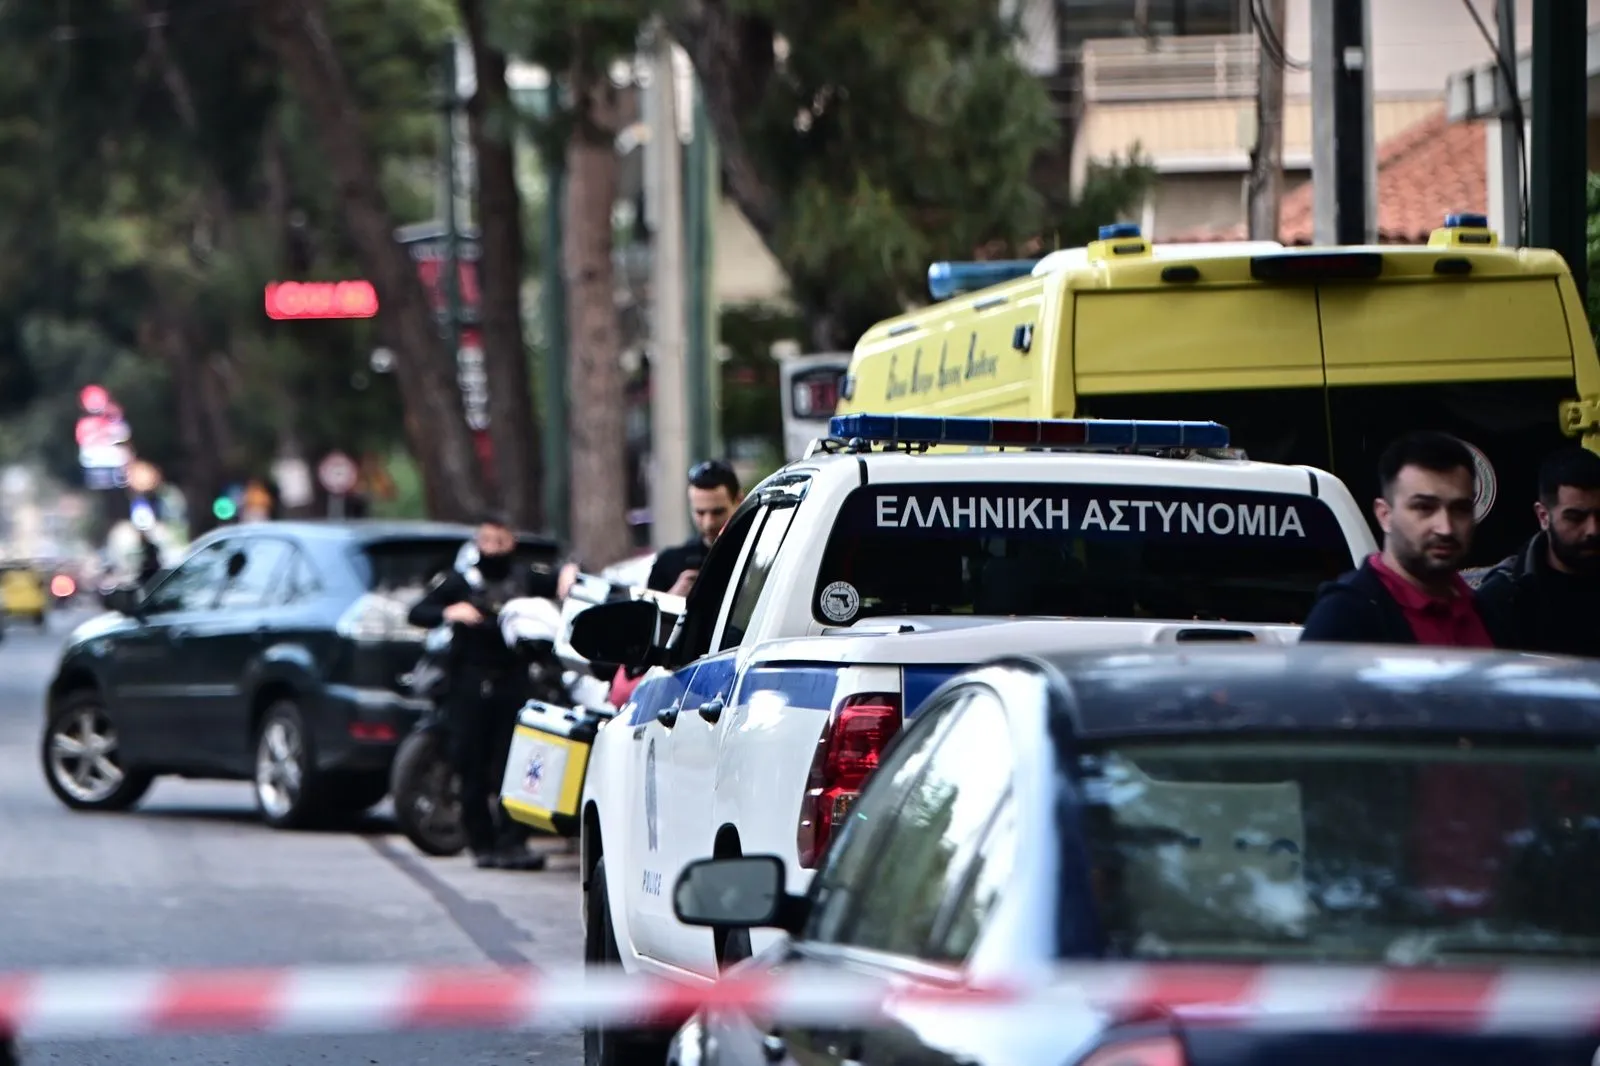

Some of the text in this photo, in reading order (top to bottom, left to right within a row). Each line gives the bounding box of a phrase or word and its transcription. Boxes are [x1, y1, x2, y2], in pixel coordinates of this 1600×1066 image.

[876, 495, 1306, 537] ΕΛΛΗΝΙΚΗ ΑΣΤΥΝΟΜΙΑ
[642, 869, 661, 896] POLICE
